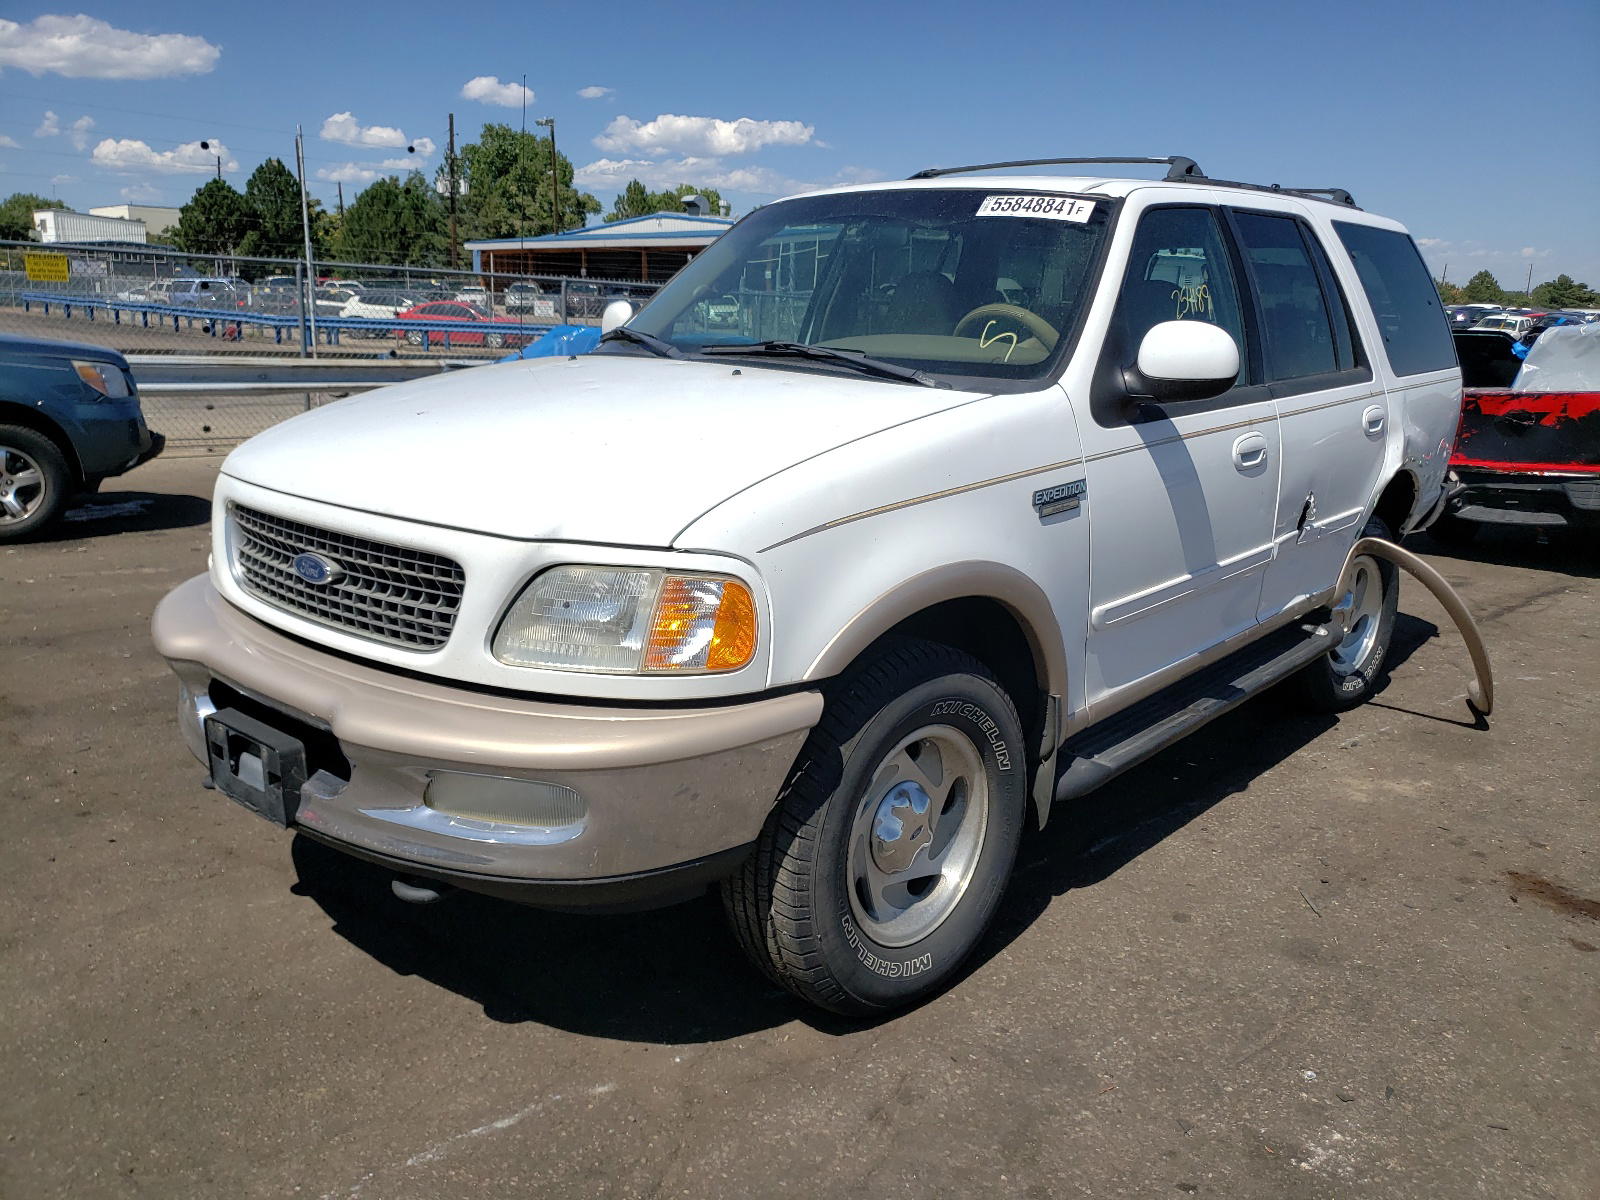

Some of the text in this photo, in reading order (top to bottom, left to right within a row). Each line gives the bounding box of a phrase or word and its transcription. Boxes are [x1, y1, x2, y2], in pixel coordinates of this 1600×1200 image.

[1034, 480, 1087, 505] EXPEDITION
[299, 560, 321, 579] Ford
[930, 700, 1011, 771] MICHELIN
[841, 914, 932, 978] MICHELIN
